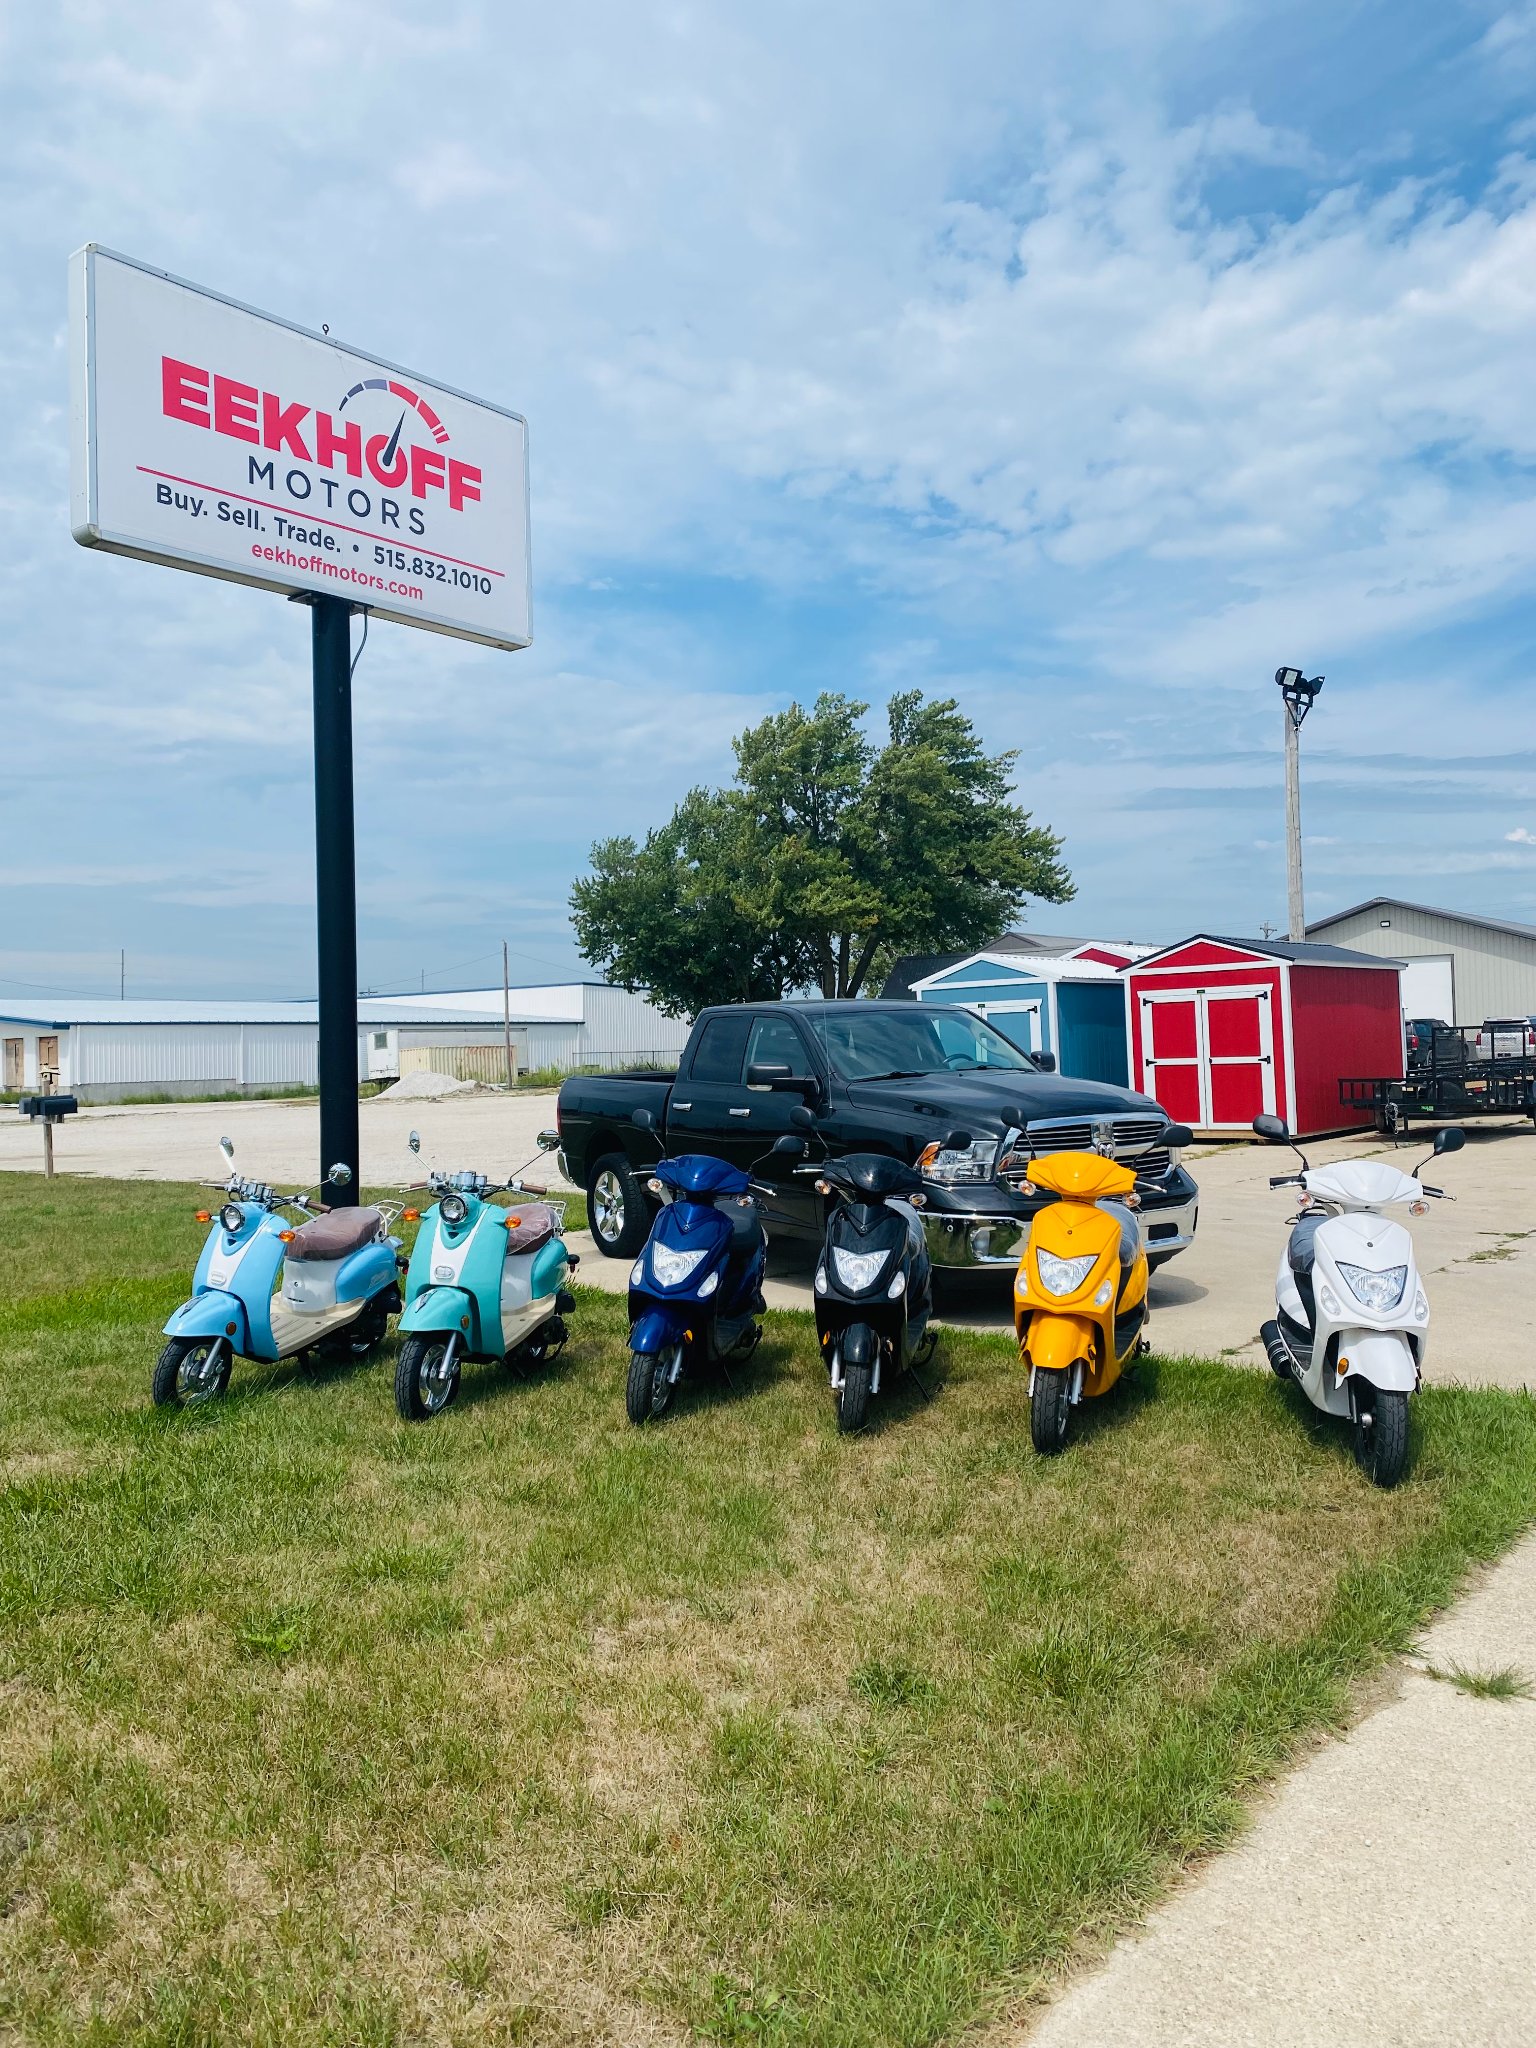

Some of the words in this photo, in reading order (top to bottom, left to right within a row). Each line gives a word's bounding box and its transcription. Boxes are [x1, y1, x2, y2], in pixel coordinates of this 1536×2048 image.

[162, 356, 481, 512] EEKHOFF
[156, 482, 208, 517] Buy.
[218, 501, 266, 533] Sell.
[274, 516, 341, 553] Trade.
[374, 545, 492, 595] 515.832.1010
[249, 456, 425, 536] MOTORS
[252, 544, 423, 600] eekhoffmotors.com
